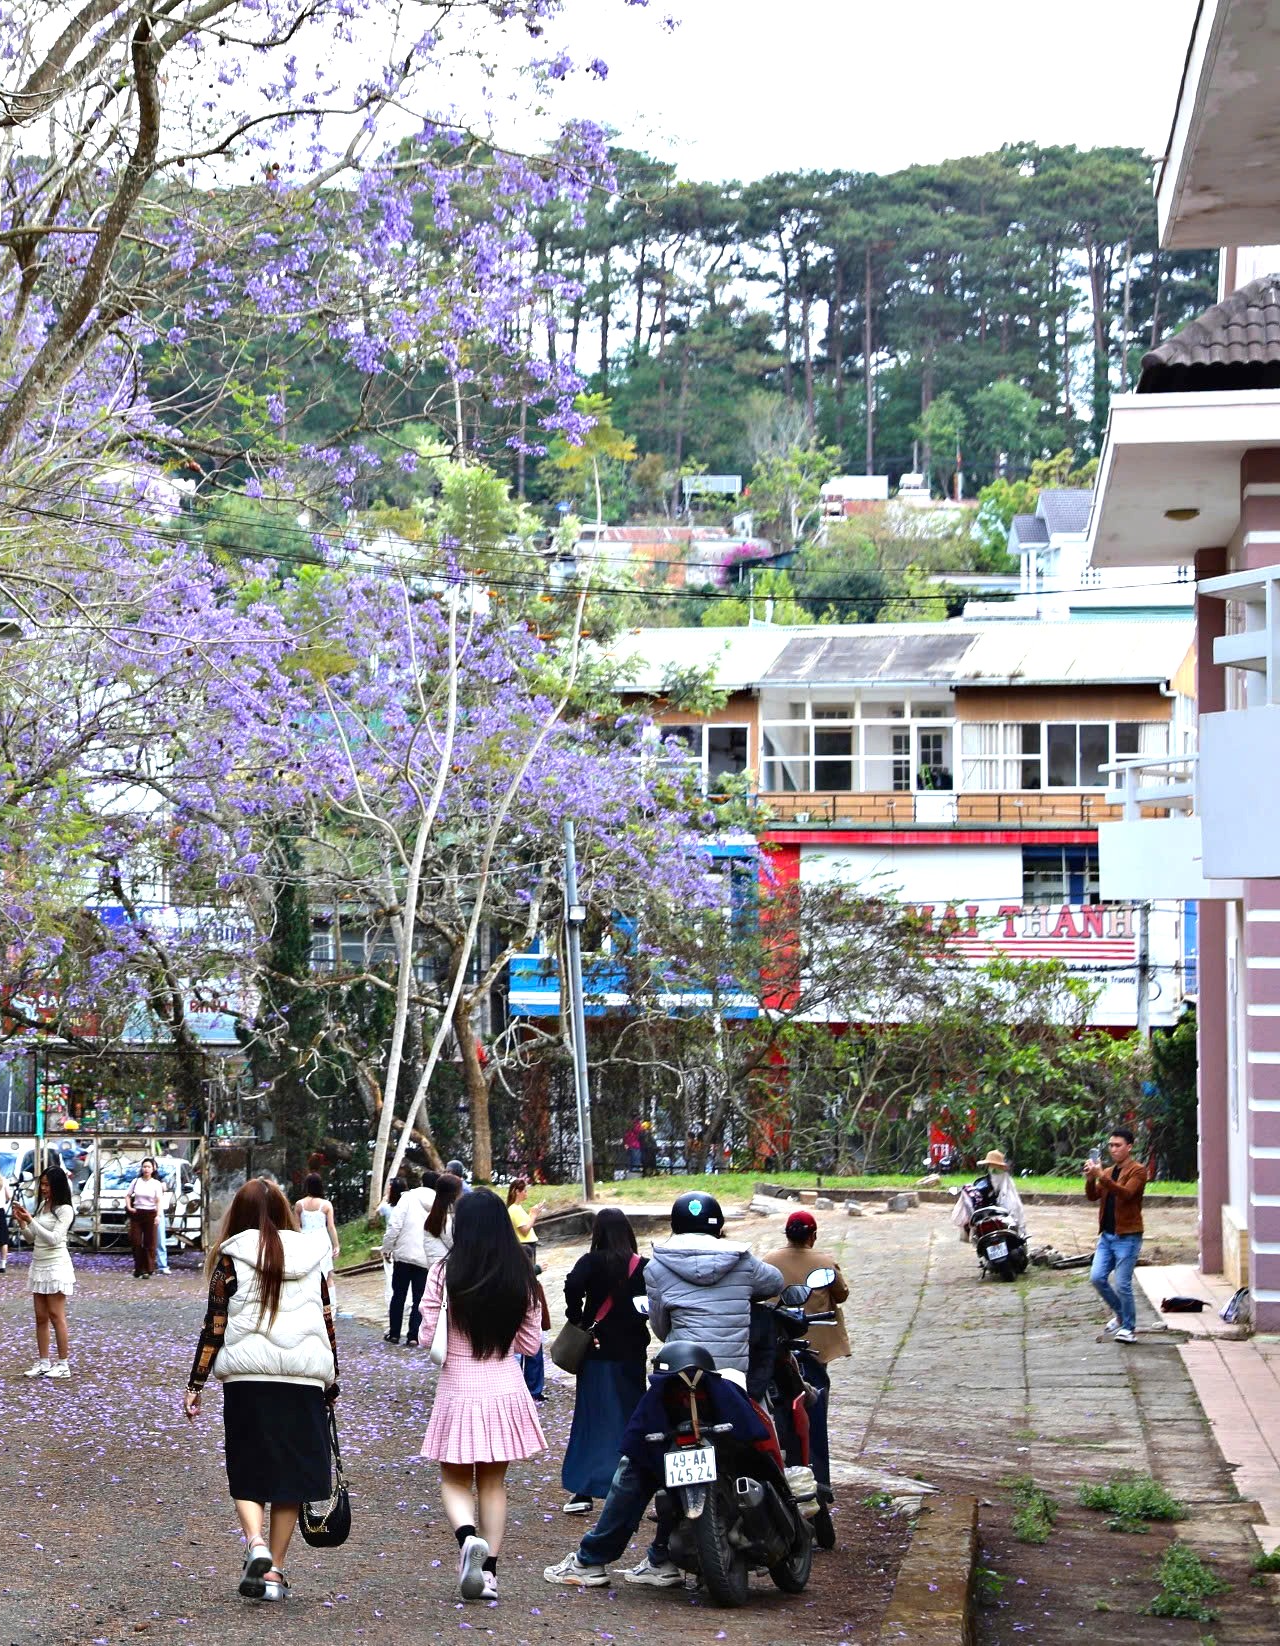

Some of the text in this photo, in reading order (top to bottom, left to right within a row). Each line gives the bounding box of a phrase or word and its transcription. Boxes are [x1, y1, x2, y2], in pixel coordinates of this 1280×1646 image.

[998, 904, 1136, 939] THANH
[672, 1450, 707, 1468] 49-AA
[669, 1465, 713, 1485] 145.24
